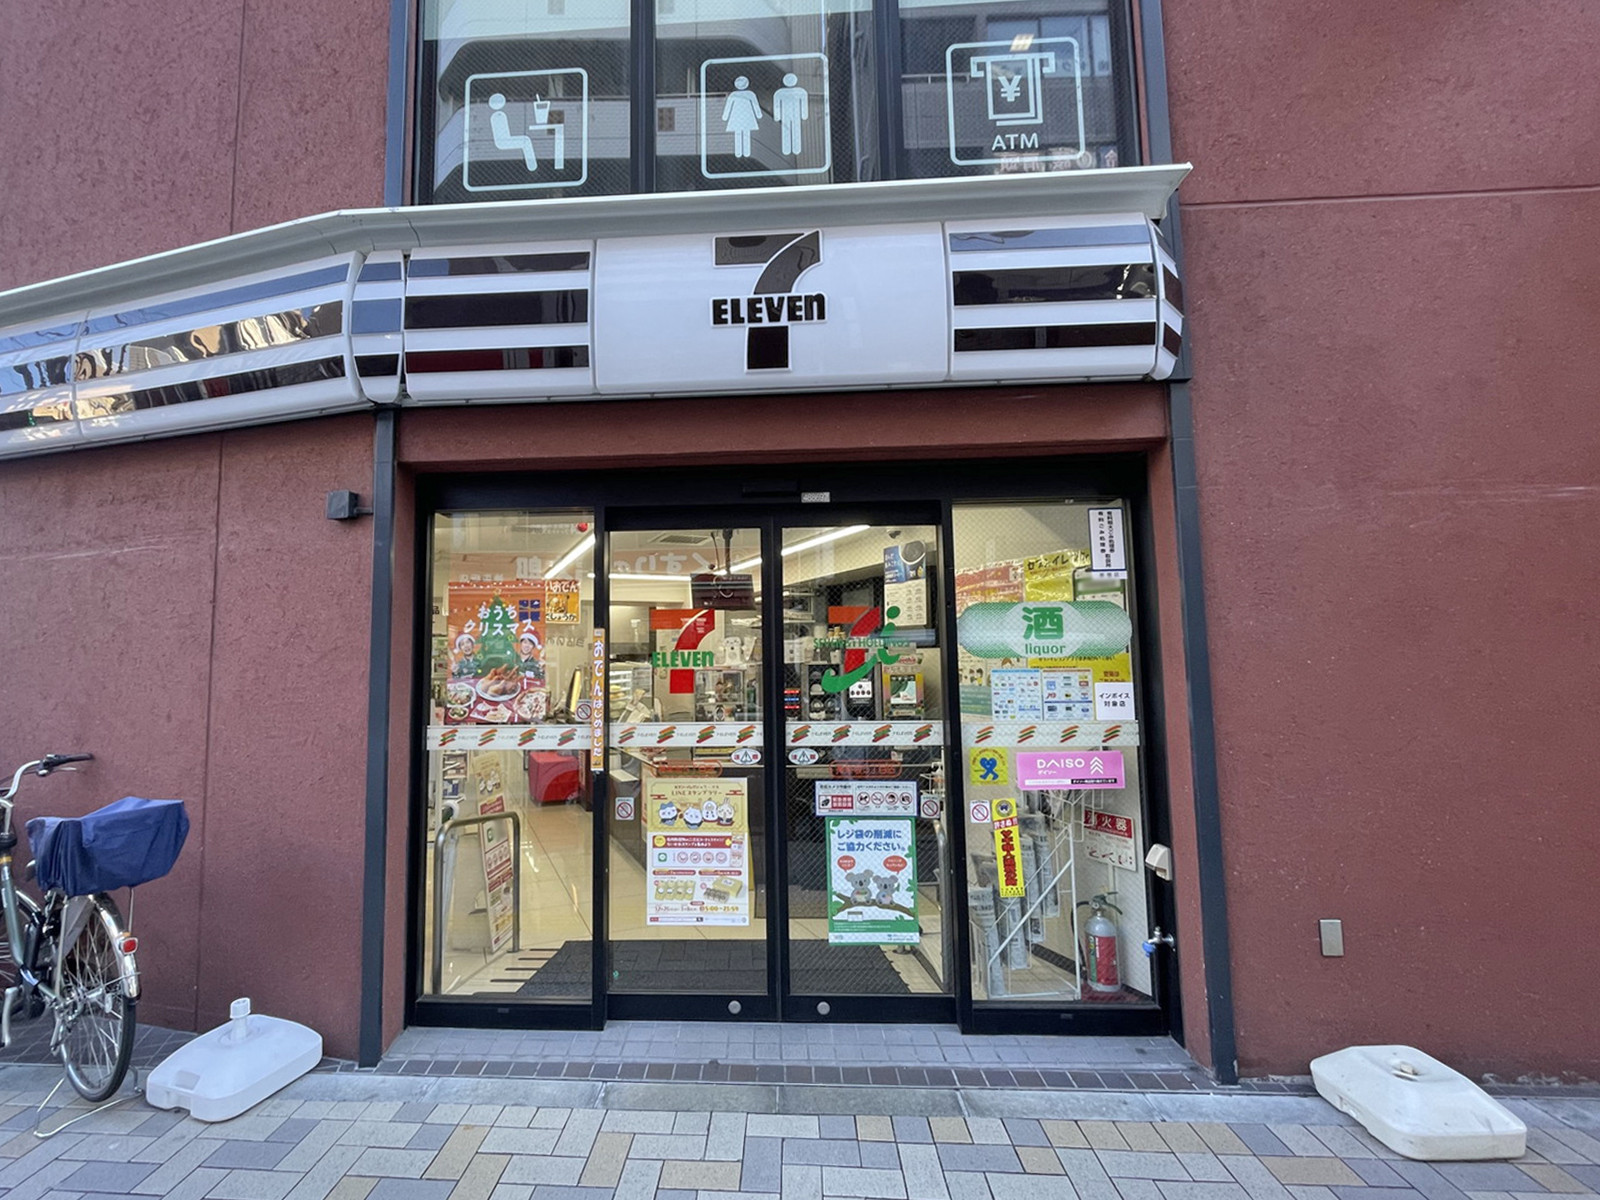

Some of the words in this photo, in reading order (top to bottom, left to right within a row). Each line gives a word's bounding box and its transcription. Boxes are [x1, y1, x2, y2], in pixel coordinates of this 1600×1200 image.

[991, 133, 1039, 151] ATM
[715, 230, 821, 370] 7
[477, 602, 518, 620] おうち
[463, 618, 535, 637] クリスマス
[1021, 606, 1064, 640] 酒
[1025, 643, 1066, 655] liquor
[1036, 758, 1085, 768] DAISO
[837, 829, 902, 839] レジ袋の削減に
[837, 842, 906, 851] ご協力ください。
